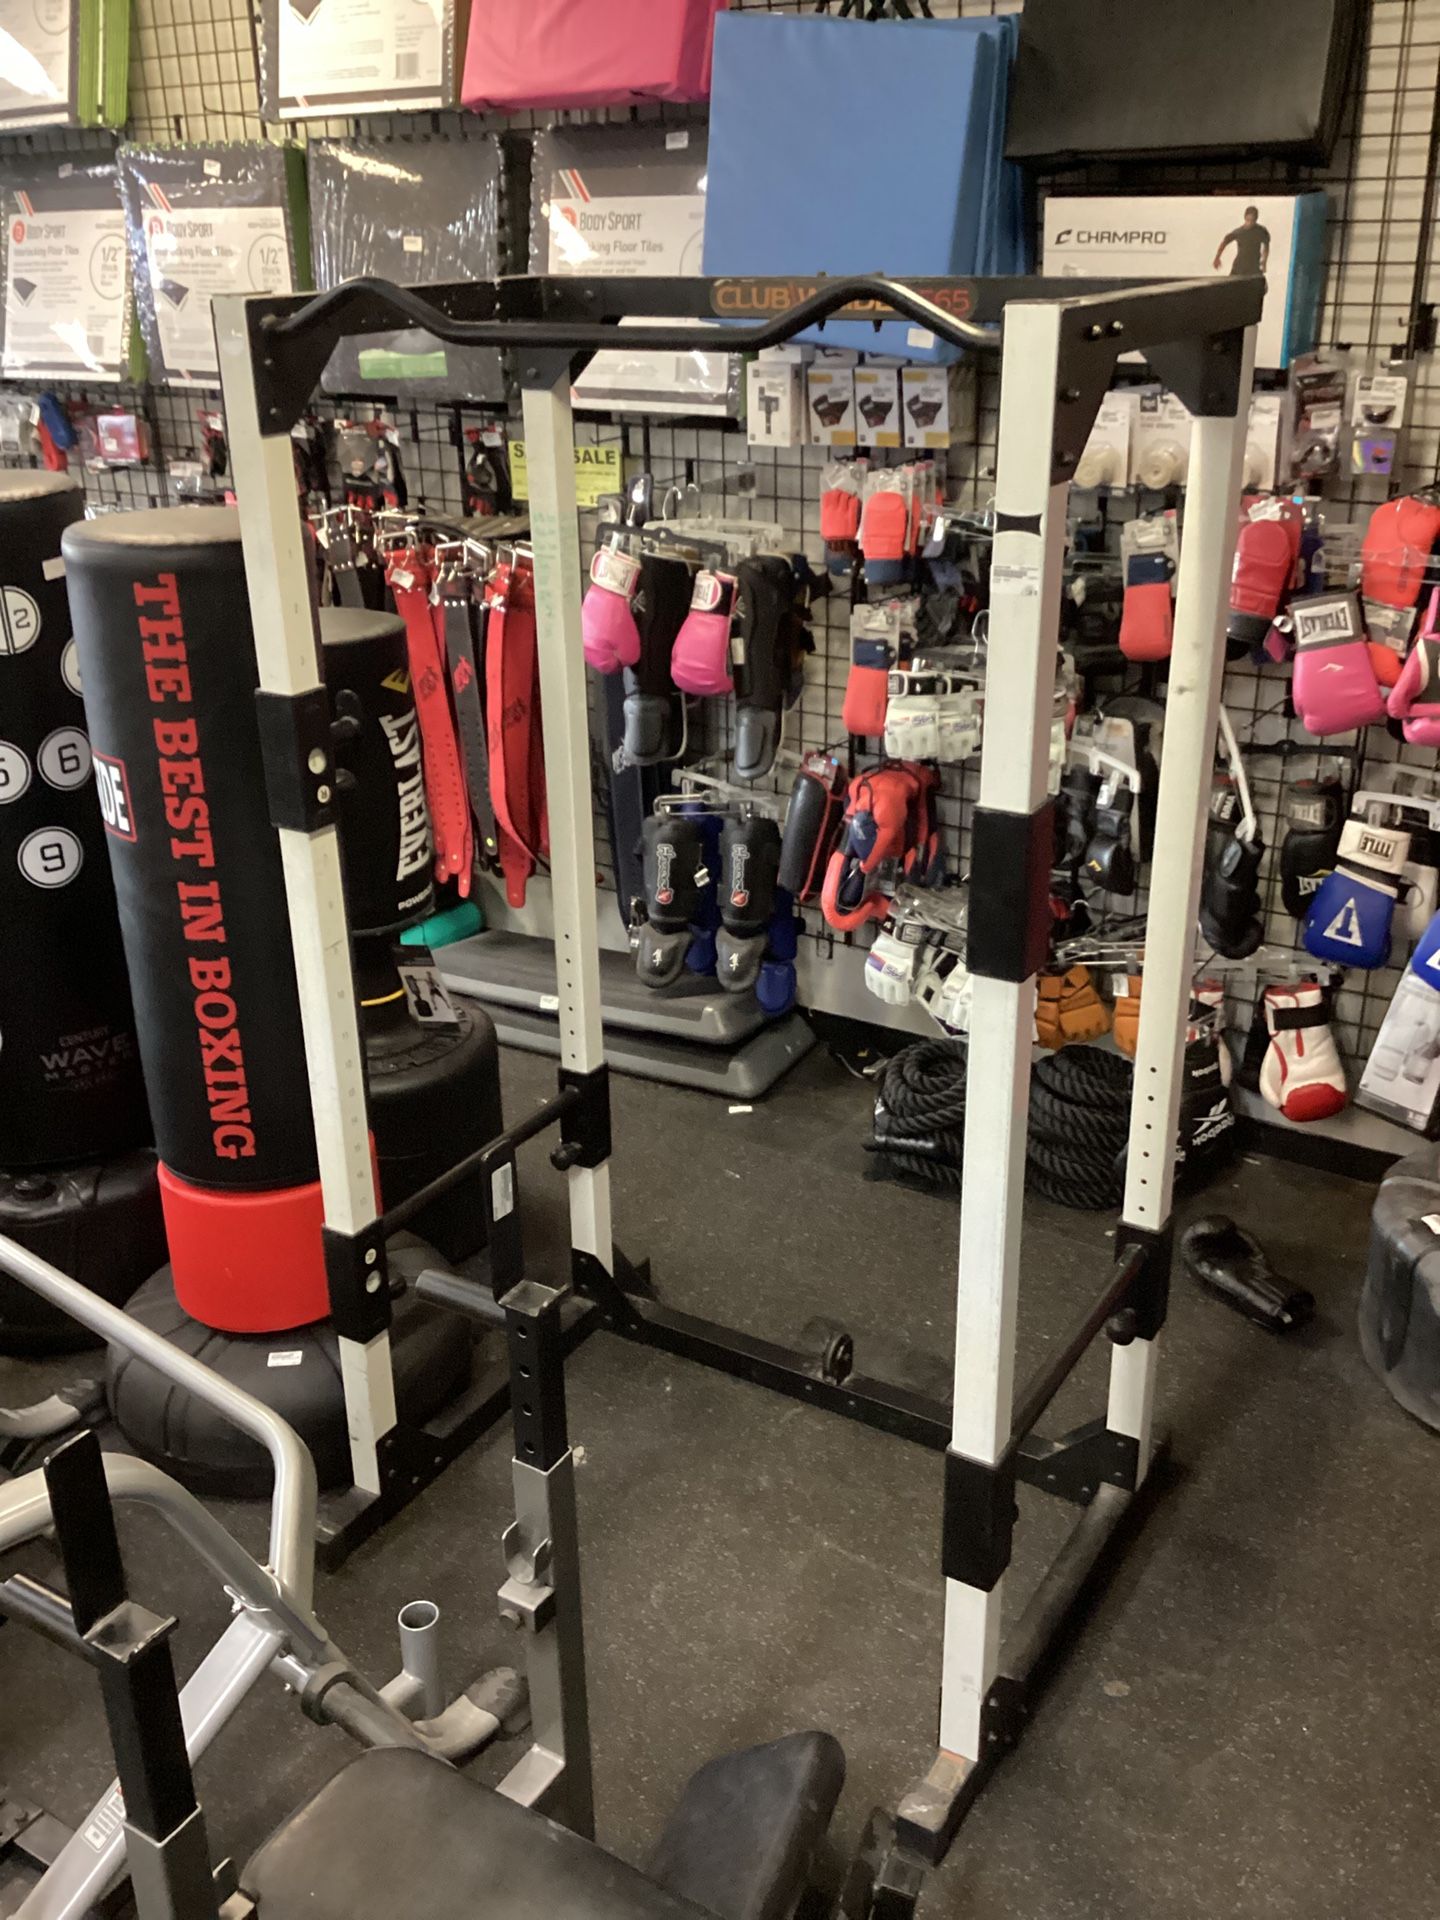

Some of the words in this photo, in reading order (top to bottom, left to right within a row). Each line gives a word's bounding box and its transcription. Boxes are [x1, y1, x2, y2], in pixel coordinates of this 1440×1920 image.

[188, 221, 213, 239] SPORT
[580, 212, 606, 231] BODY
[608, 210, 642, 231] SPORT
[613, 239, 638, 252] Floor
[641, 239, 664, 253] Tiles
[1076, 230, 1167, 244] CHAMPRO
[716, 287, 791, 310] CLUB
[13, 608, 31, 630] 2
[133, 573, 193, 703] THE
[58, 743, 80, 774] 6
[153, 717, 216, 868] BEST
[39, 843, 66, 873] 9
[1360, 836, 1393, 859] TITLE
[177, 880, 227, 943] IN
[188, 956, 257, 1160] BOXING
[1191, 1112, 1235, 1146] Reebok
